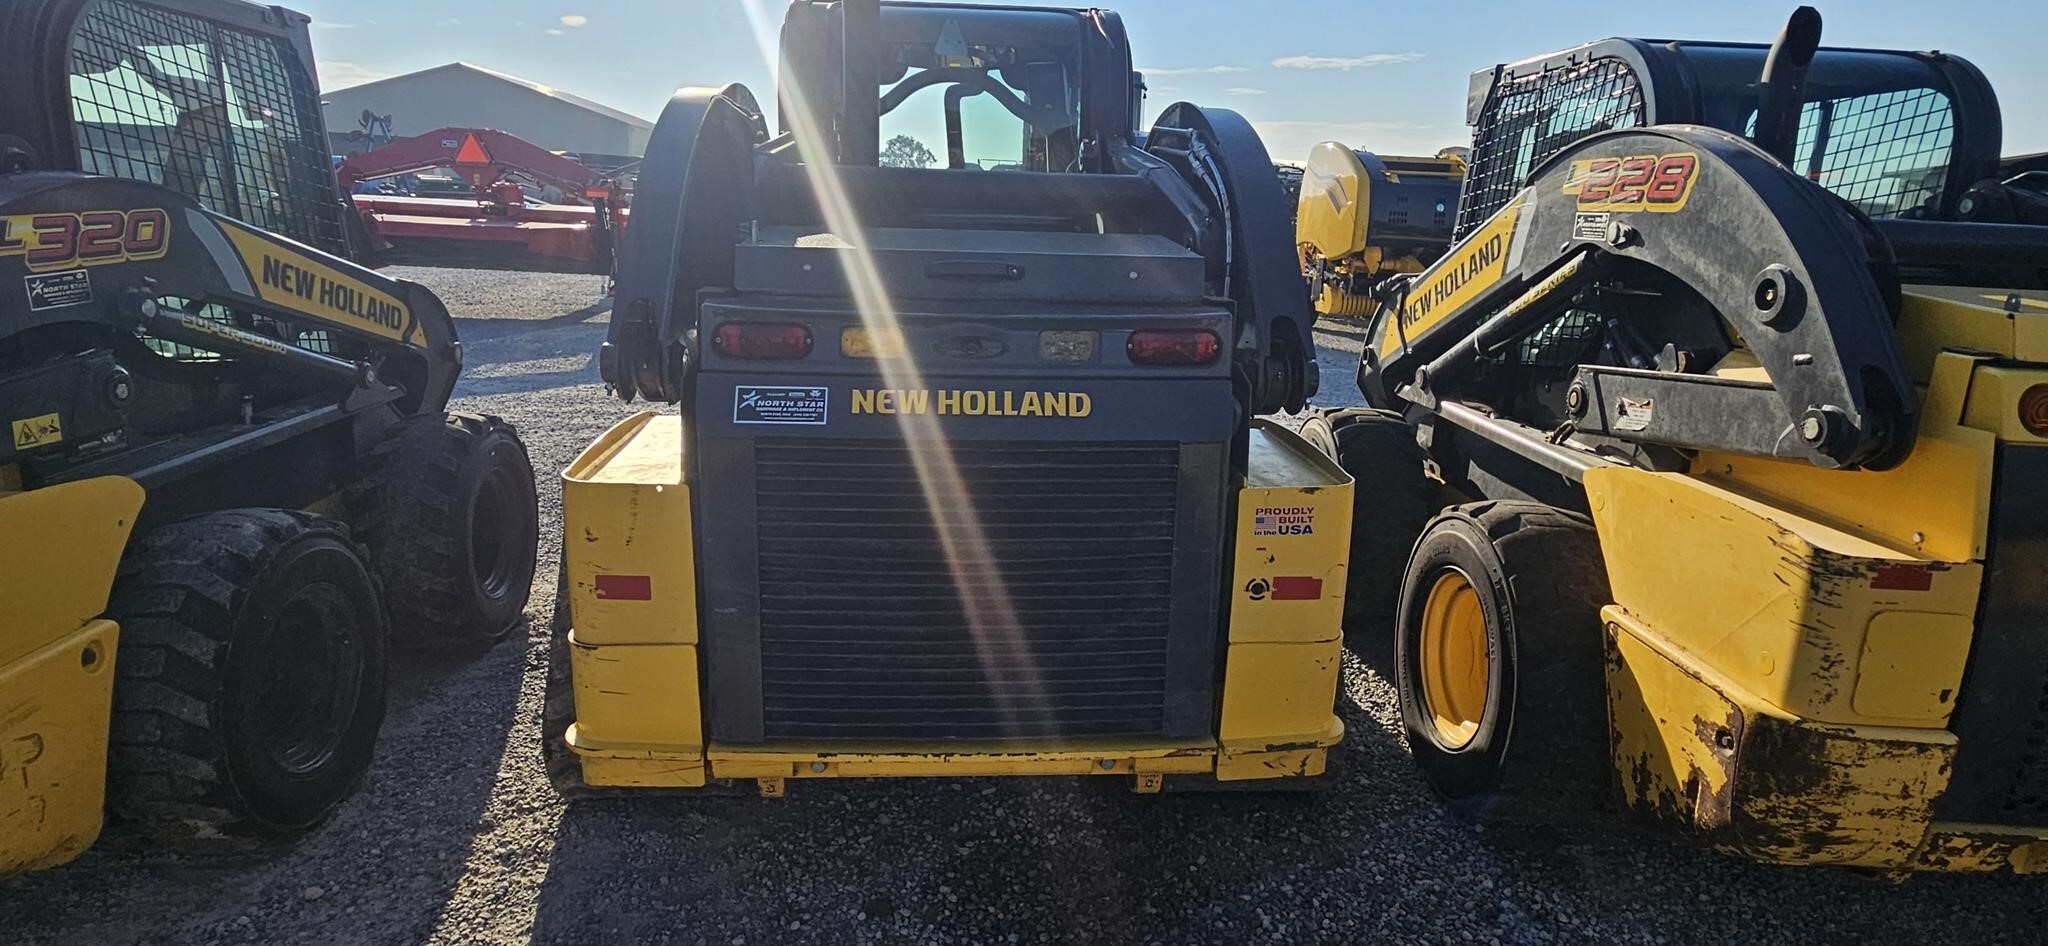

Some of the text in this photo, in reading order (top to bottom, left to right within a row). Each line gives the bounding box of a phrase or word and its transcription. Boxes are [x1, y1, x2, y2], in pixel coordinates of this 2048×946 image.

[1404, 233, 1502, 330] NEW HOLLAND
[43, 285, 69, 293] NORTH
[263, 254, 402, 330] NEW HOLLAND
[851, 389, 1092, 417] NEW HOLLAND
[1255, 507, 1314, 515] PROUDLY
[1278, 516, 1314, 524] BUILT
[1278, 525, 1313, 535] USA
